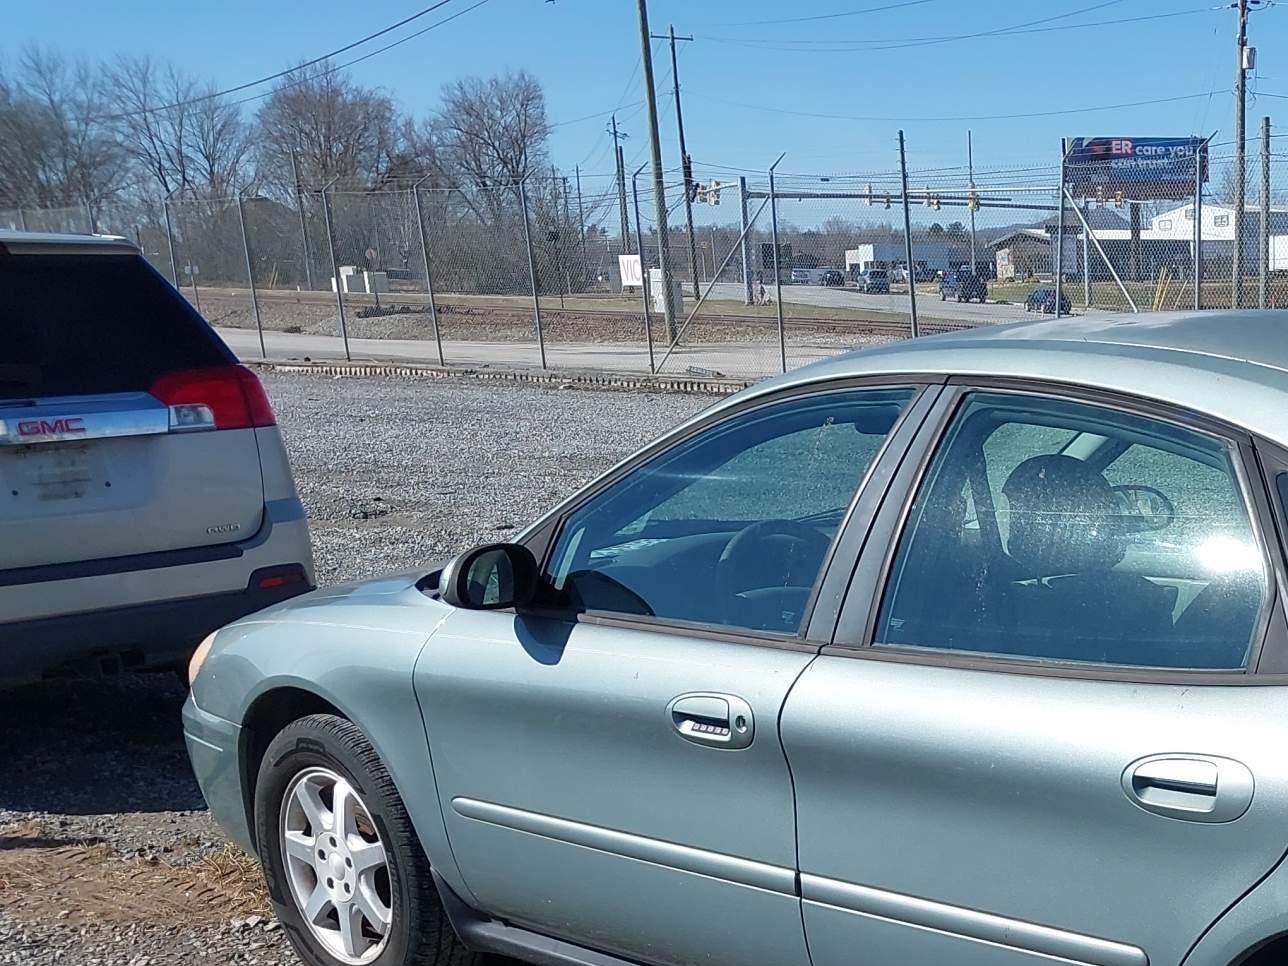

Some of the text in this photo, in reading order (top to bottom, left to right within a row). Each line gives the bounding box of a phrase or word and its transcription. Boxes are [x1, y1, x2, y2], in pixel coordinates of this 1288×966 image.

[1111, 140, 1194, 158] ER care you
[18, 418, 86, 435] GMC
